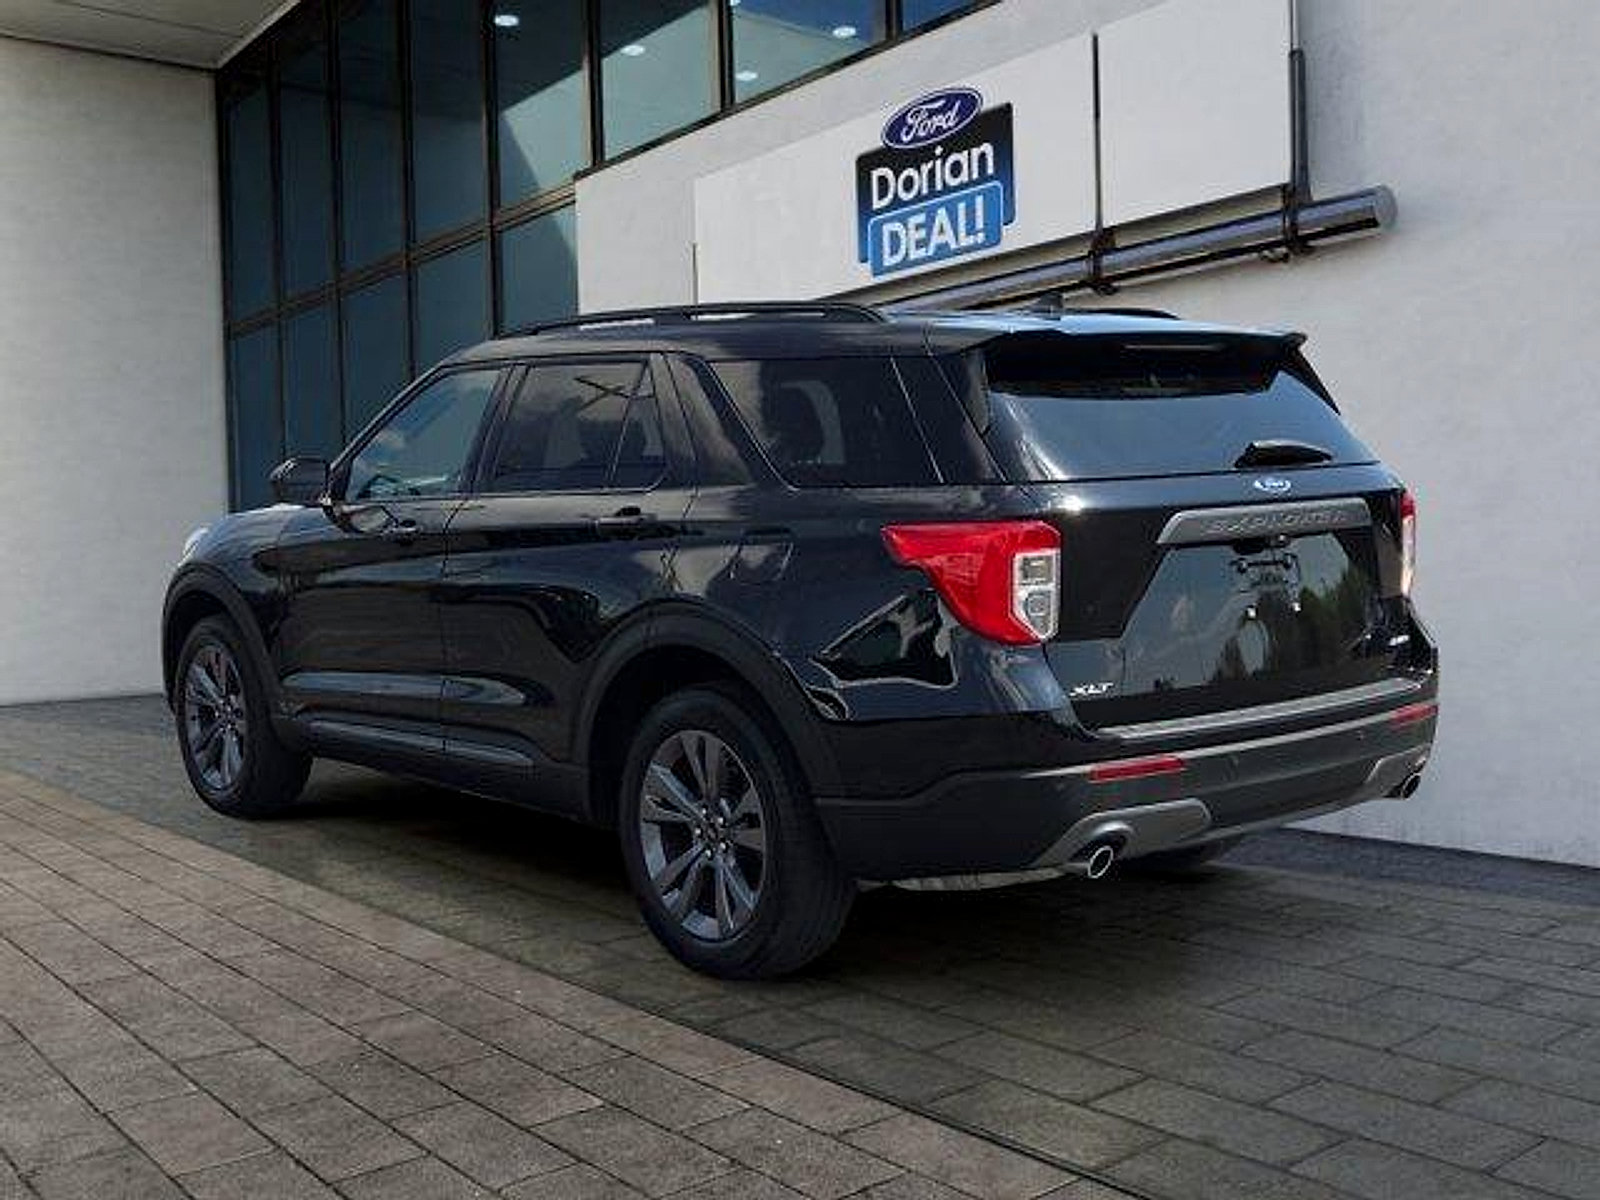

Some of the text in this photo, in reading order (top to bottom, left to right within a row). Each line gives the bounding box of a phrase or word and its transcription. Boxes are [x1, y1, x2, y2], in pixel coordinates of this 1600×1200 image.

[900, 99, 962, 143] Ford
[871, 142, 994, 209] Dorian
[882, 195, 984, 266] DEAL!
[1068, 682, 1115, 697] XLT
